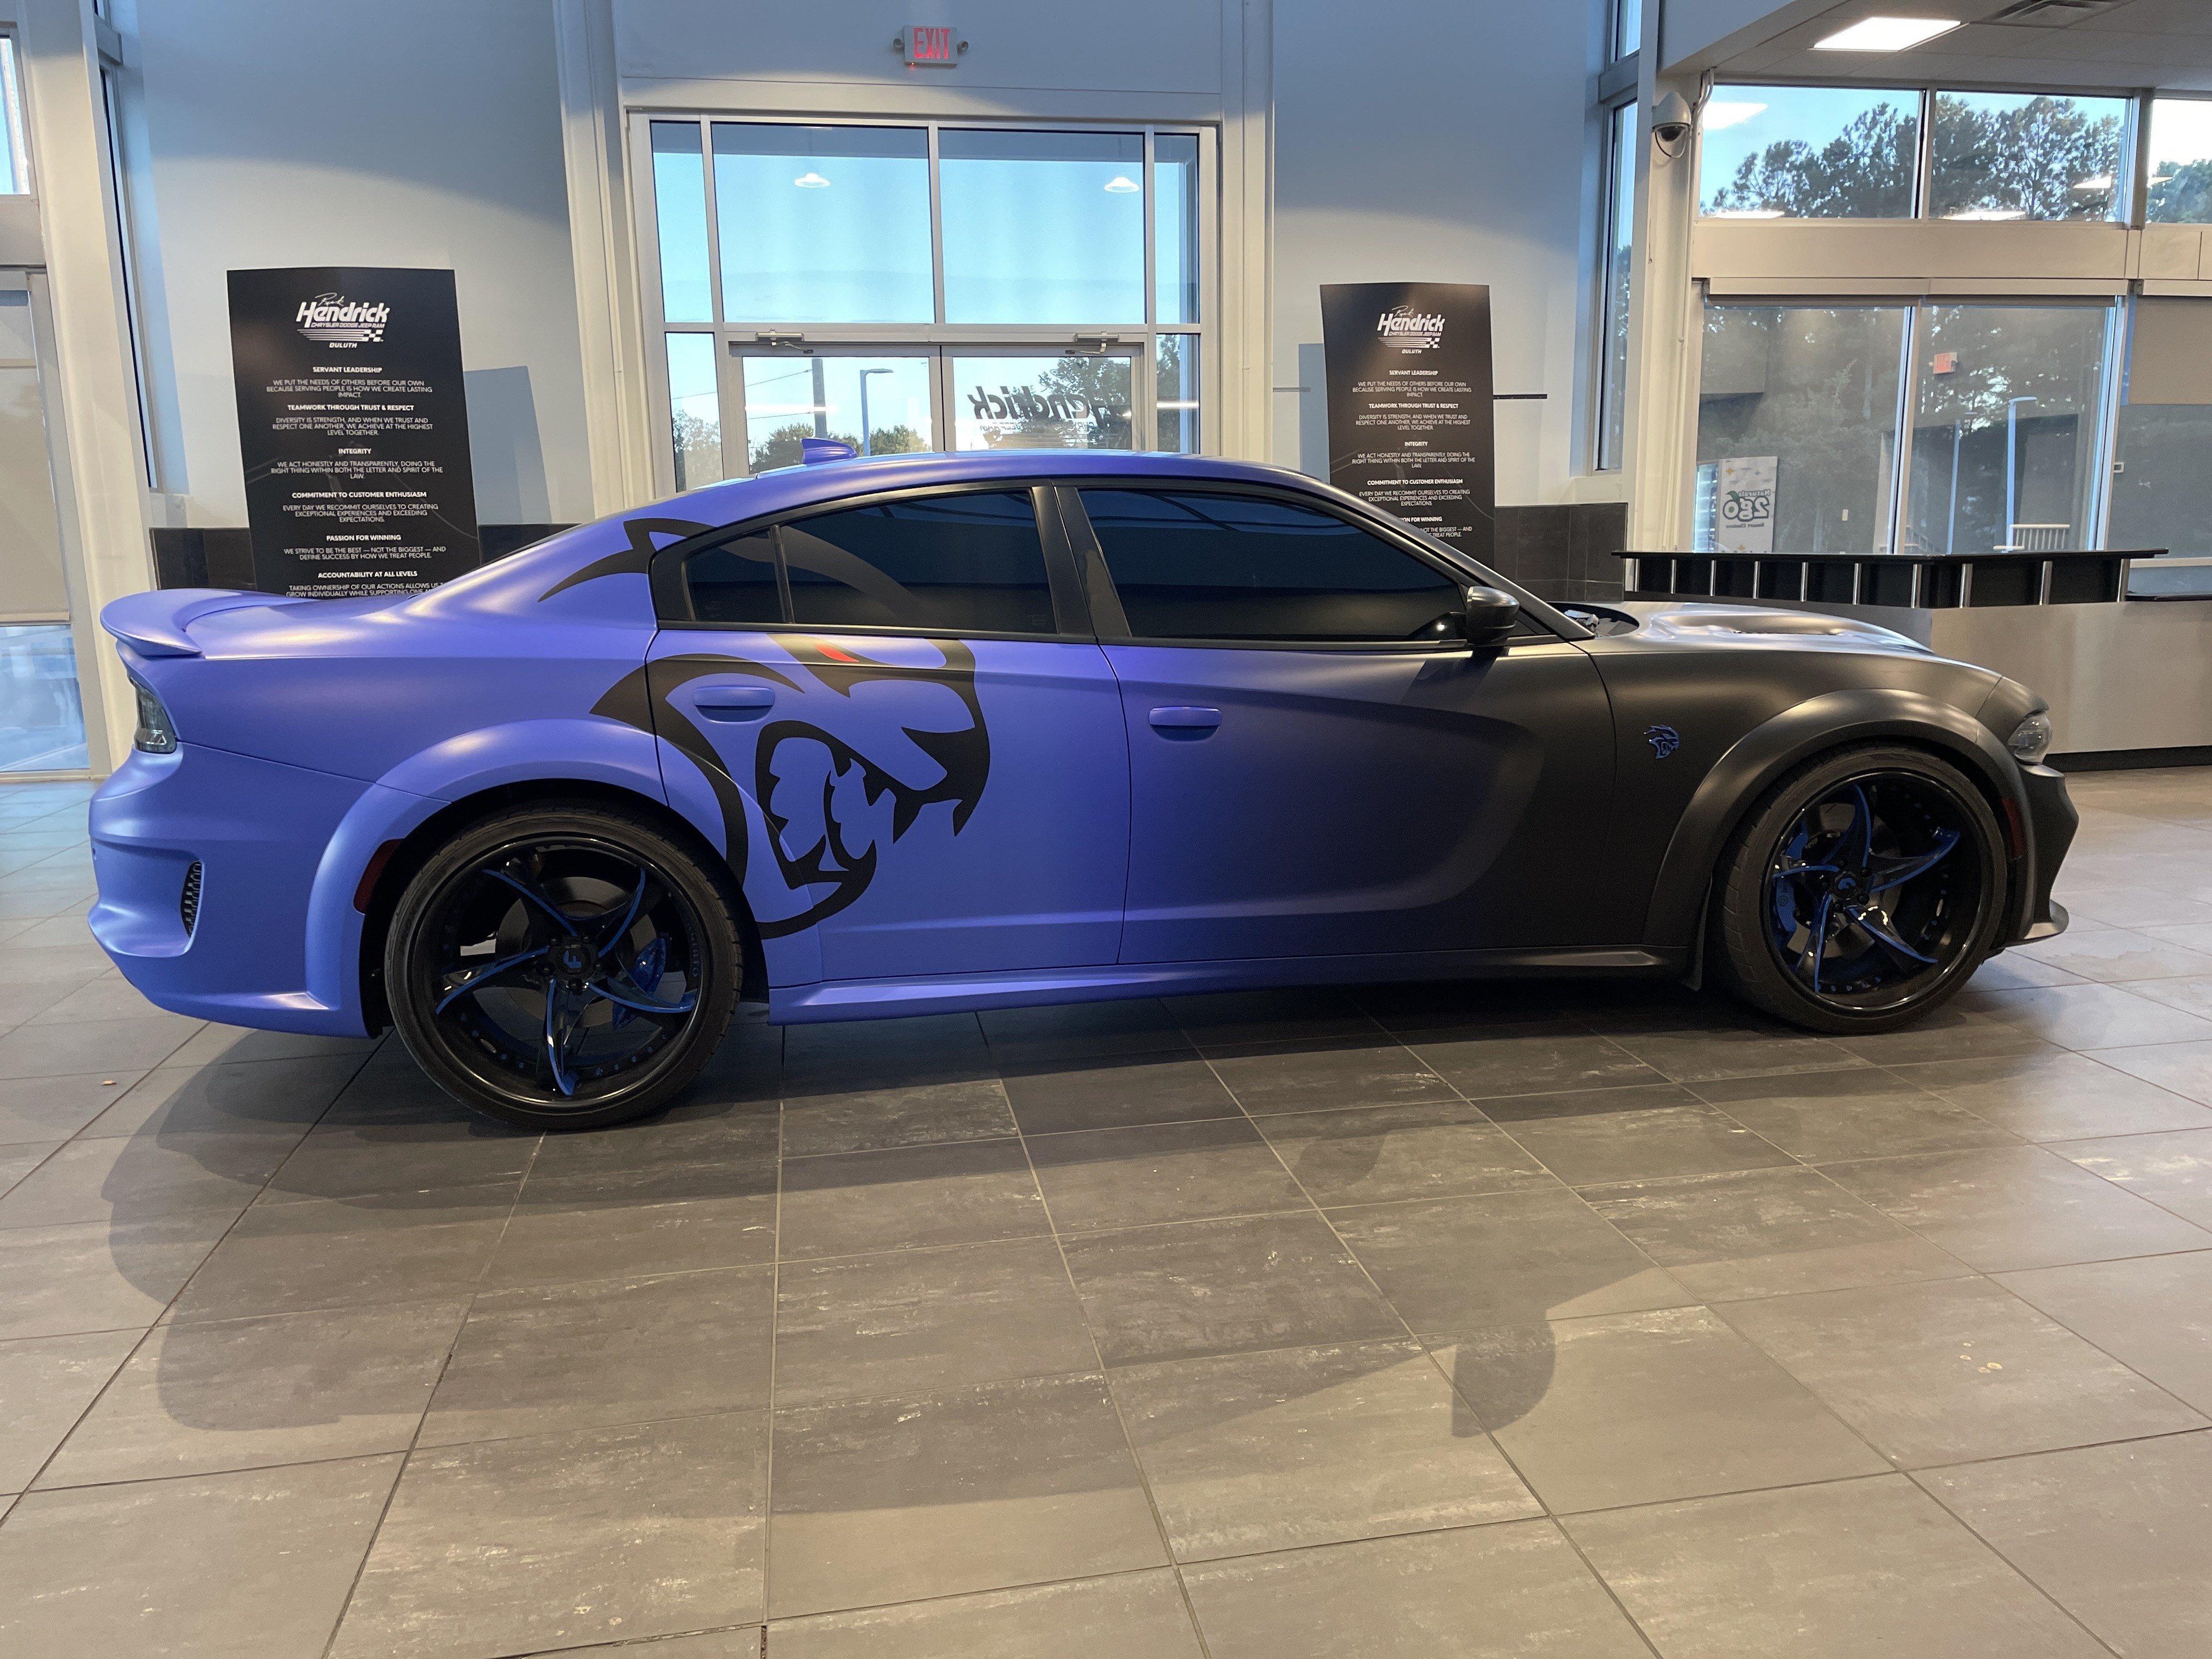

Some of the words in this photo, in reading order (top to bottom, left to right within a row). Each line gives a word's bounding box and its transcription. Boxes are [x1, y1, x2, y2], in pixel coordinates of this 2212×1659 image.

[913, 27, 950, 59] EXIT
[296, 302, 390, 328] Hendrick
[1377, 313, 1446, 336] Hendrick
